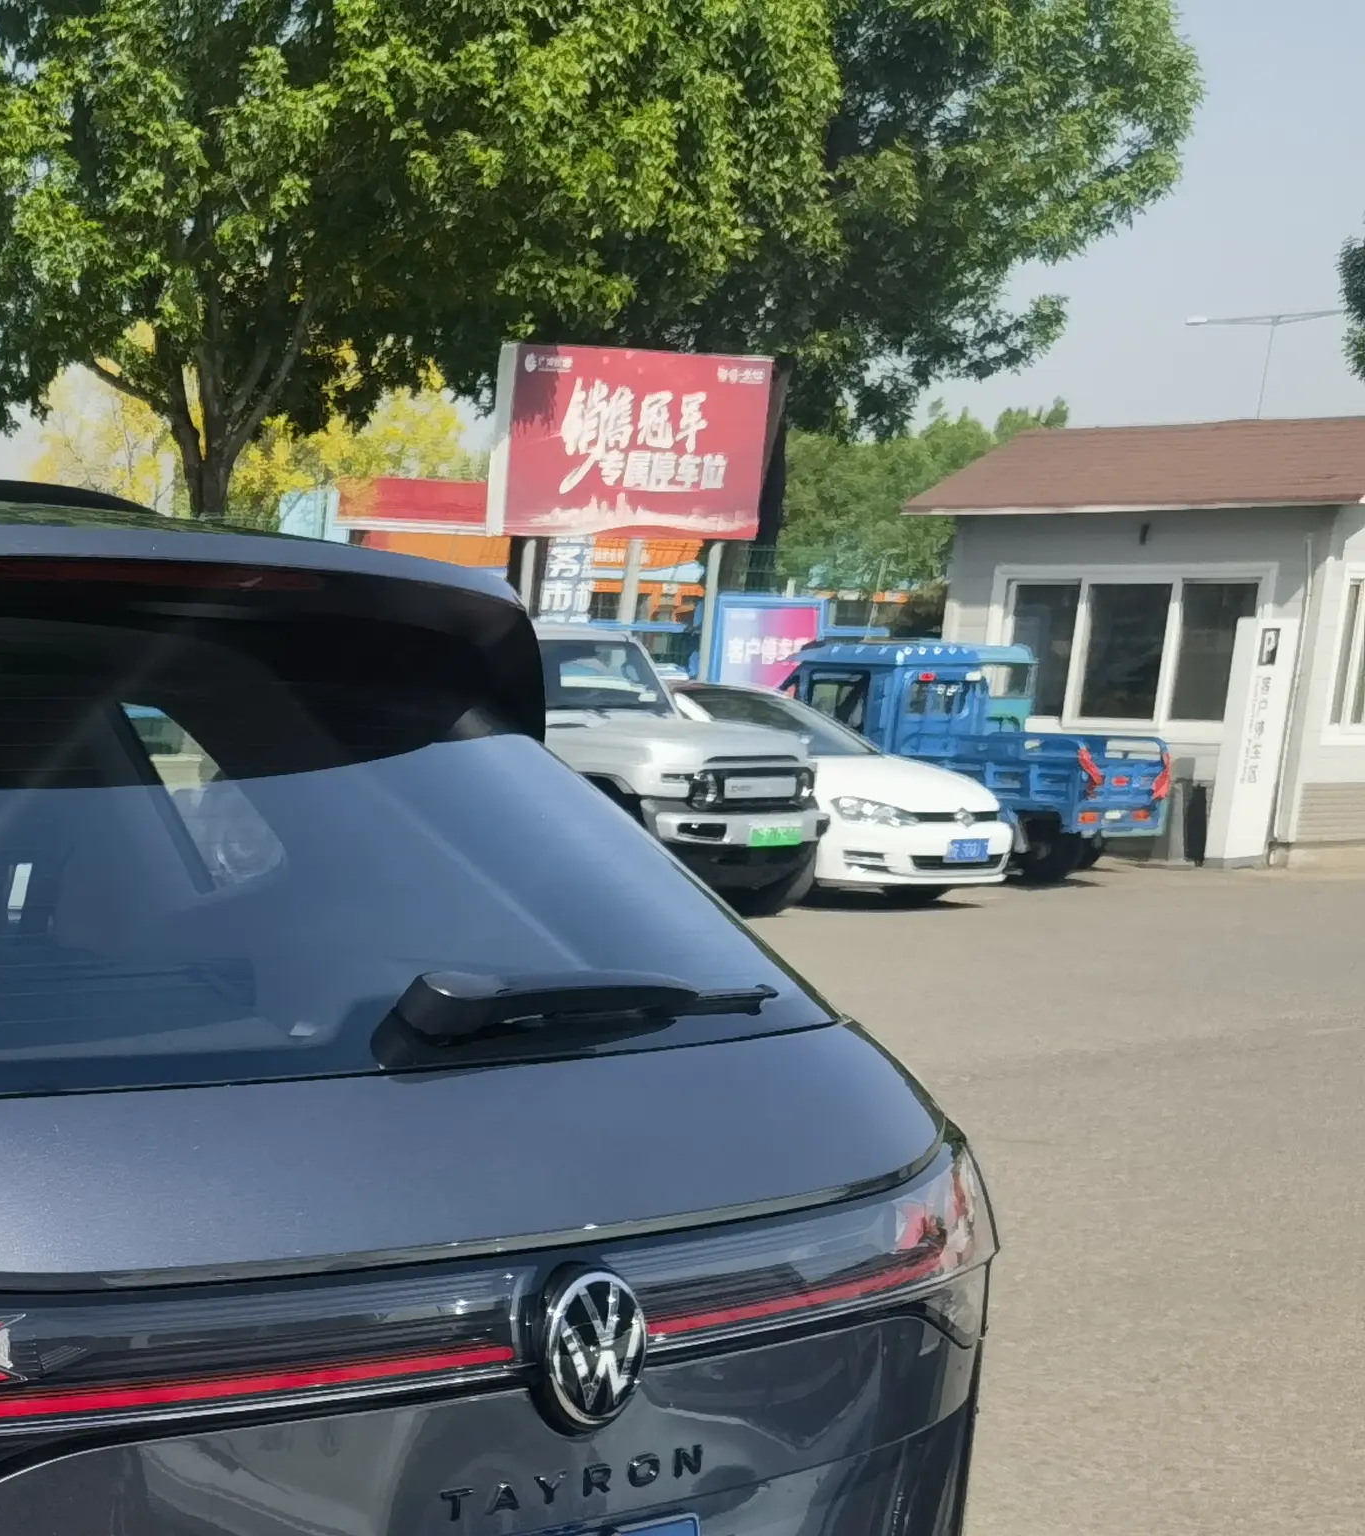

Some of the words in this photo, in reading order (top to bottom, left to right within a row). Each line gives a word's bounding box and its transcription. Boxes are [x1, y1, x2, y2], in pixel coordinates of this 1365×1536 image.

[559, 377, 709, 494] 销售冠军
[599, 451, 729, 490] 专属停车位
[439, 1444, 702, 1522] TAYRON
